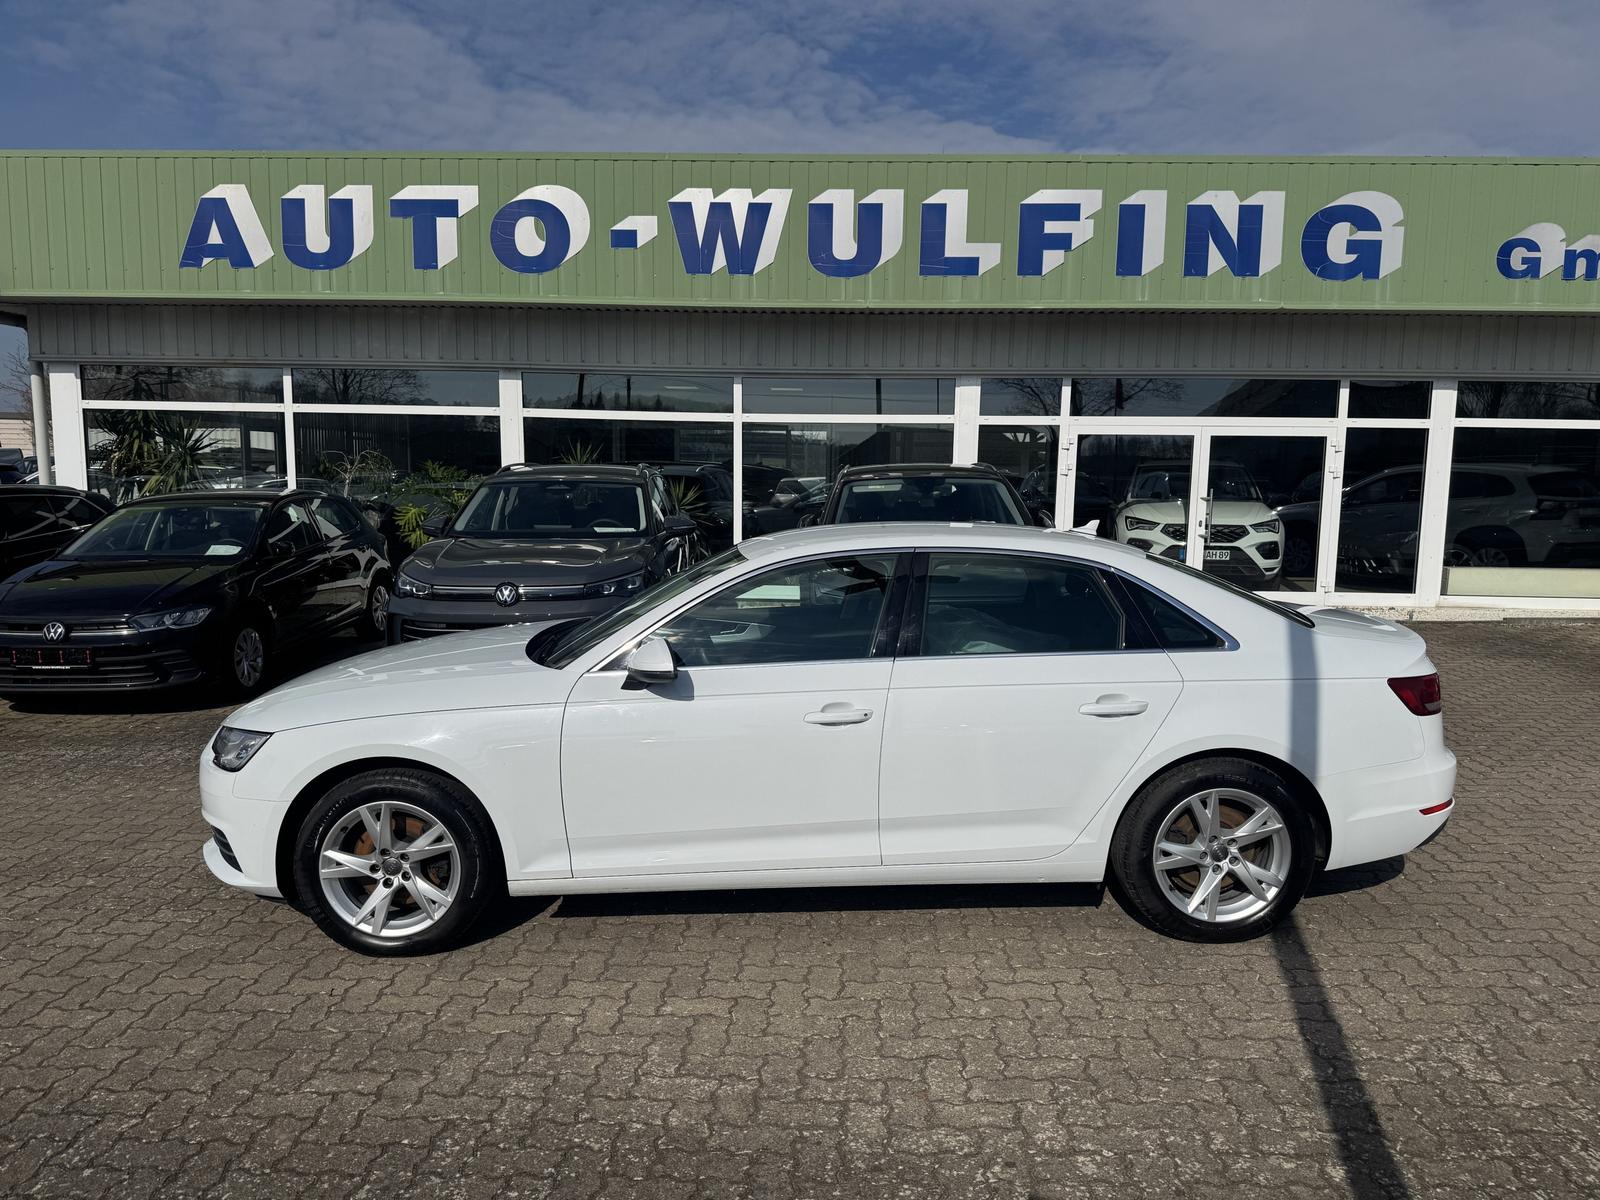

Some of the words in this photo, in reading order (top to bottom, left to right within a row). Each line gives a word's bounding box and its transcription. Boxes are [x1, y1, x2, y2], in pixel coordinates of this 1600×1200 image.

[179, 184, 1404, 282] AUTO-WULFING
[1218, 551, 1229, 559] 89
[496, 585, 517, 604] VW
[43, 622, 64, 642] VW
